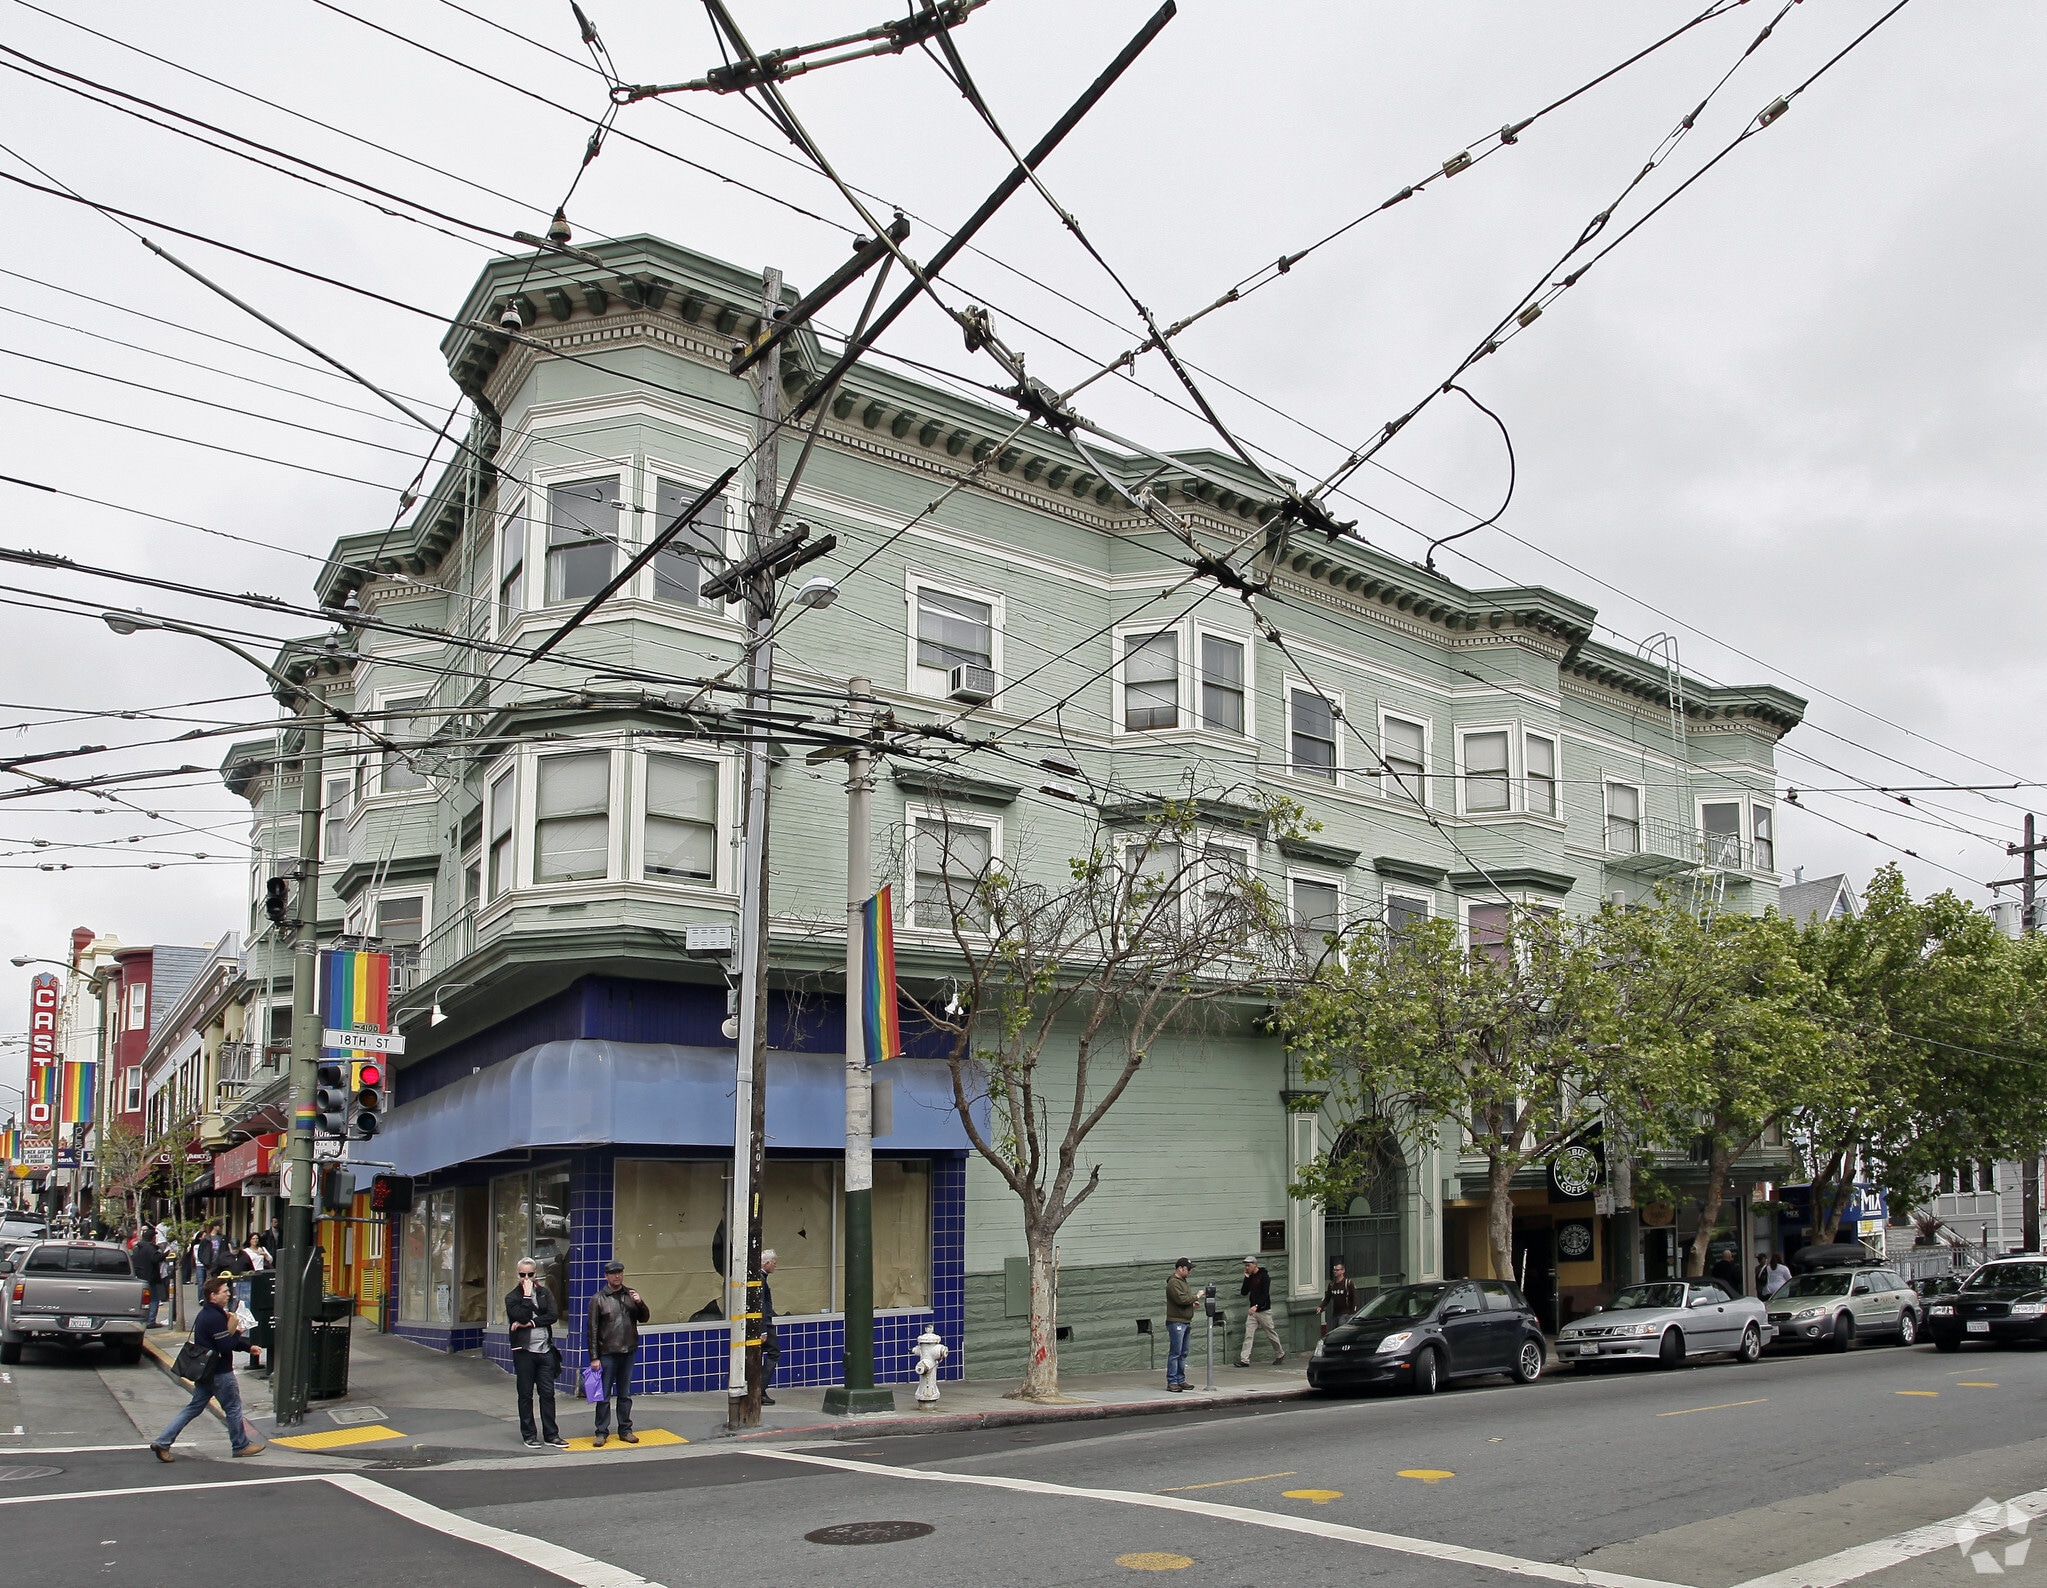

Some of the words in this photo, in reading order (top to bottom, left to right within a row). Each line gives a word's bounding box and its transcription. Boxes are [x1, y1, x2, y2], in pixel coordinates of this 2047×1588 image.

[360, 1024, 378, 1033] 4100
[340, 1034, 367, 1047] 18TH
[376, 1038, 389, 1048] ST
[31, 989, 55, 1121] CASTO
[1560, 1179, 1593, 1193] COFFEE
[1860, 1188, 1882, 1211] MIX
[1560, 1225, 1590, 1241] STARBUCKS
[1563, 1245, 1586, 1254] COFFEE
